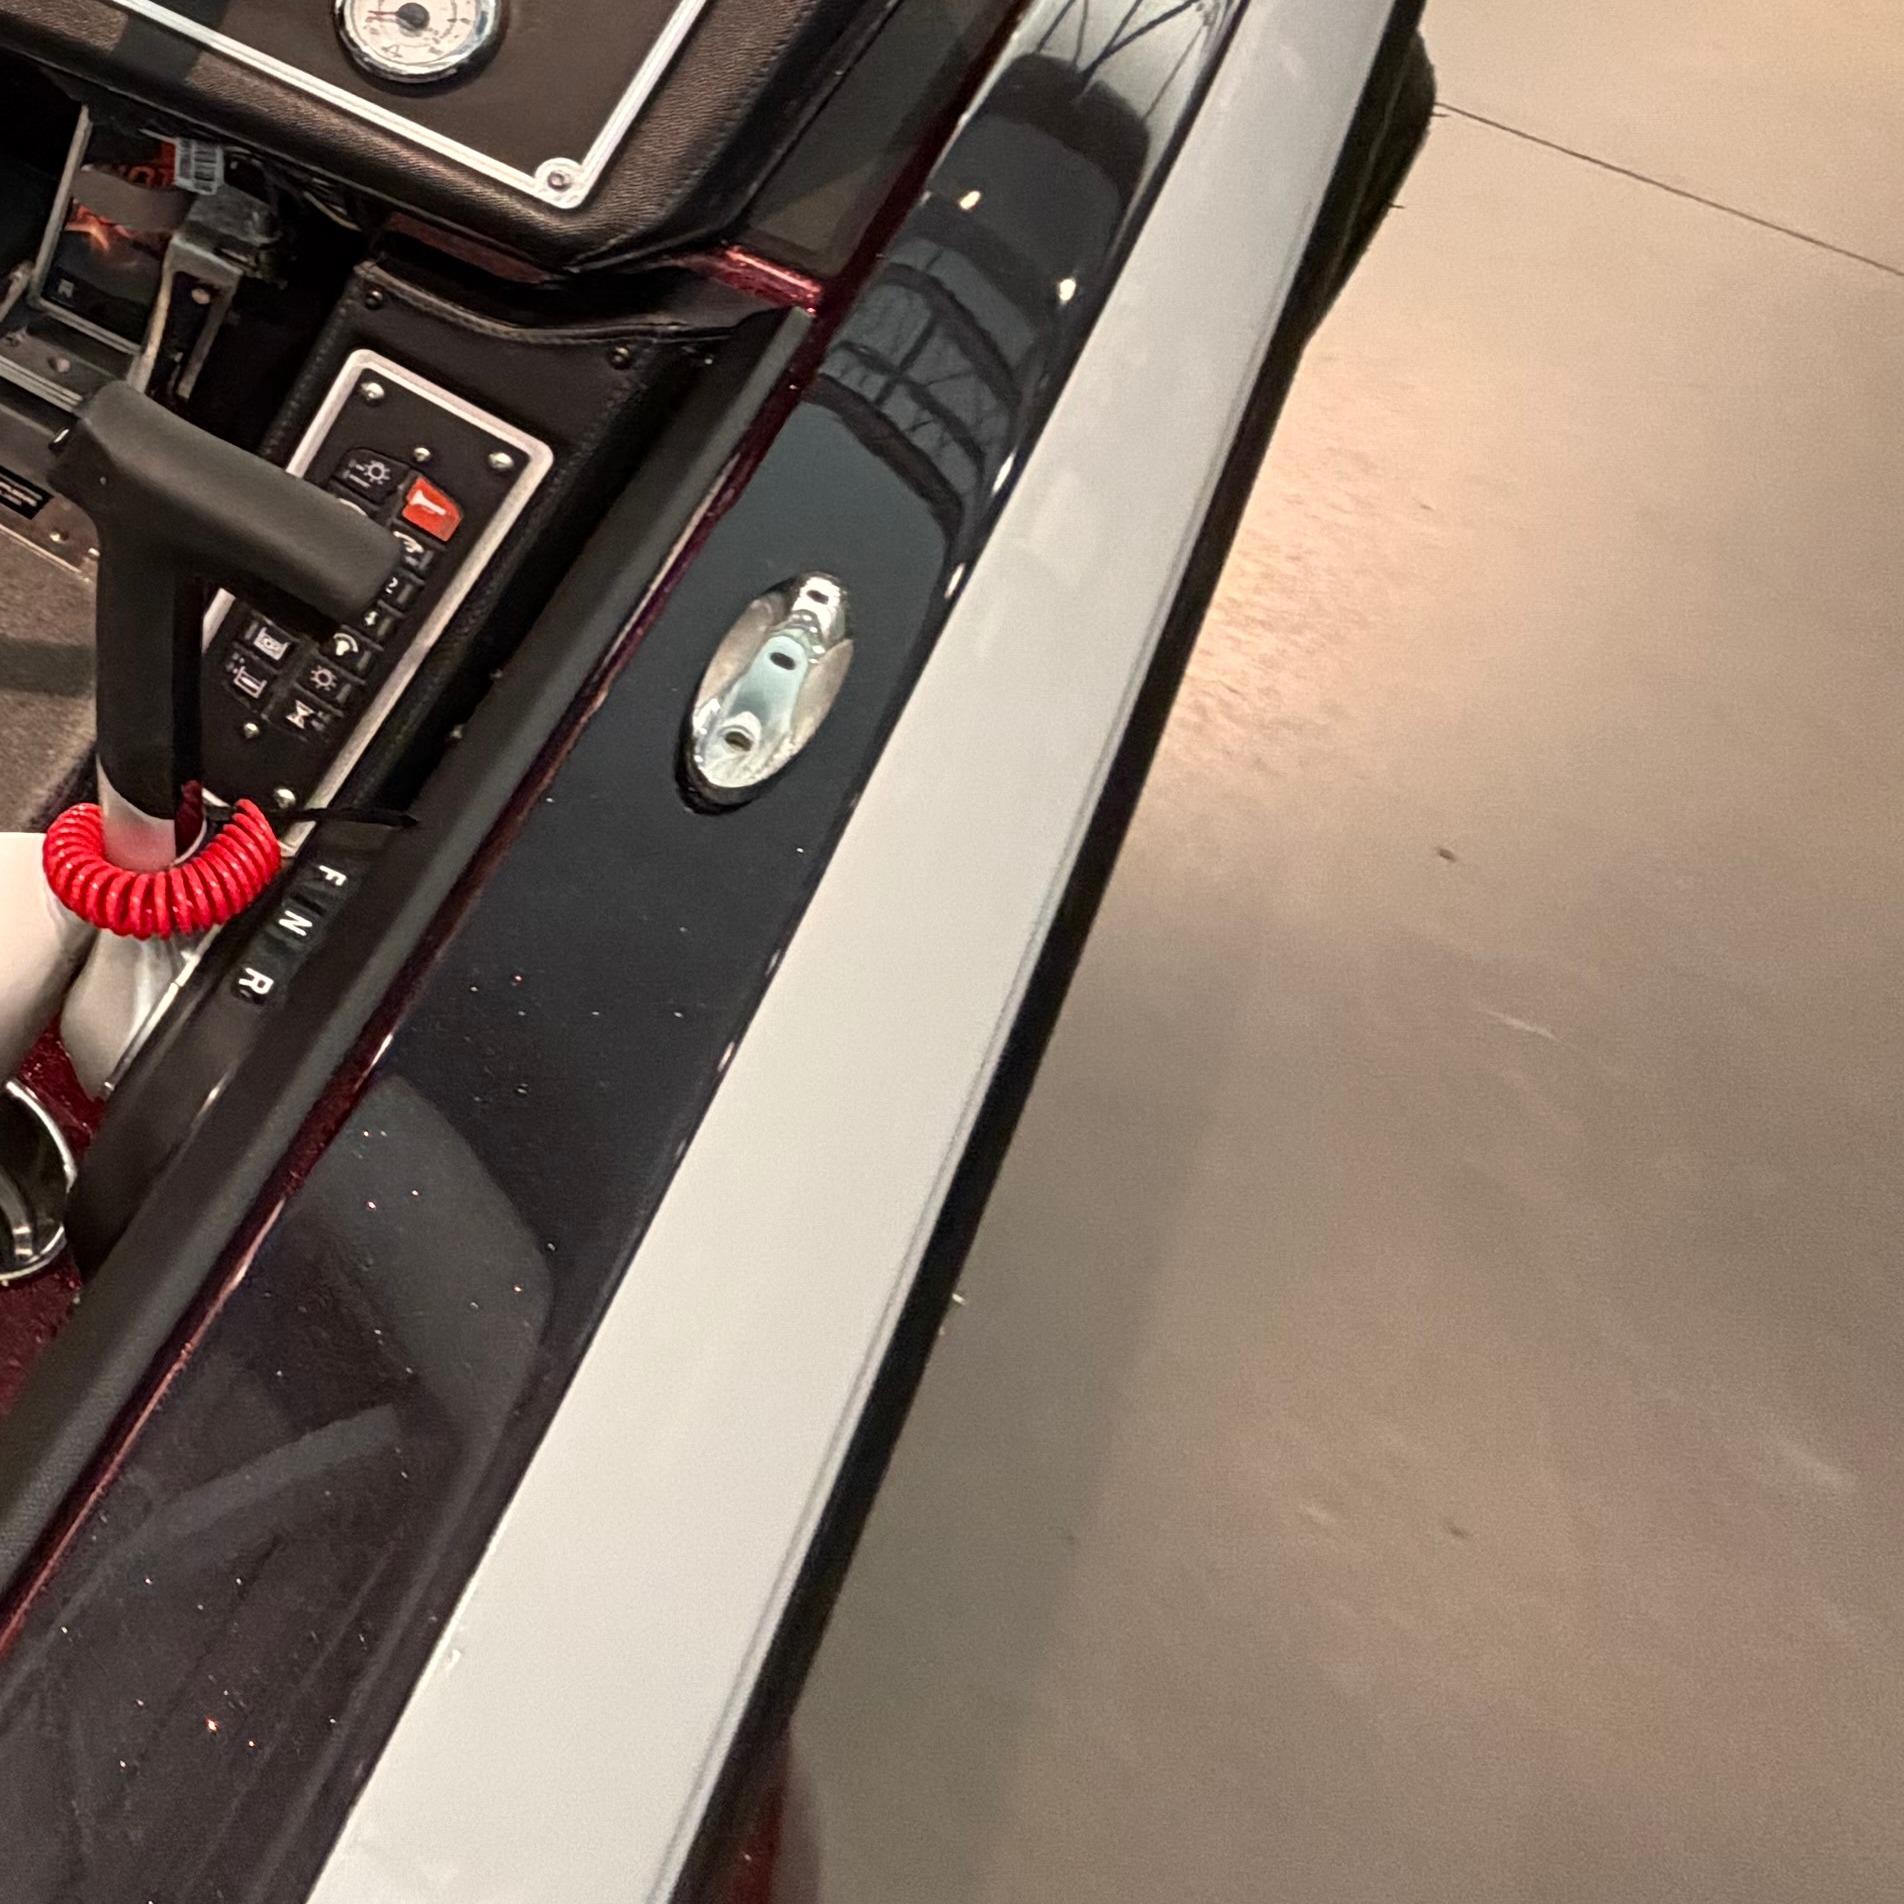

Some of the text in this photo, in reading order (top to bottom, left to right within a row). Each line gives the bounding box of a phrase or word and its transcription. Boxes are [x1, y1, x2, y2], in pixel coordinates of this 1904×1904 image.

[318, 864, 347, 887] F
[278, 910, 313, 937] N
[238, 967, 274, 995] R
